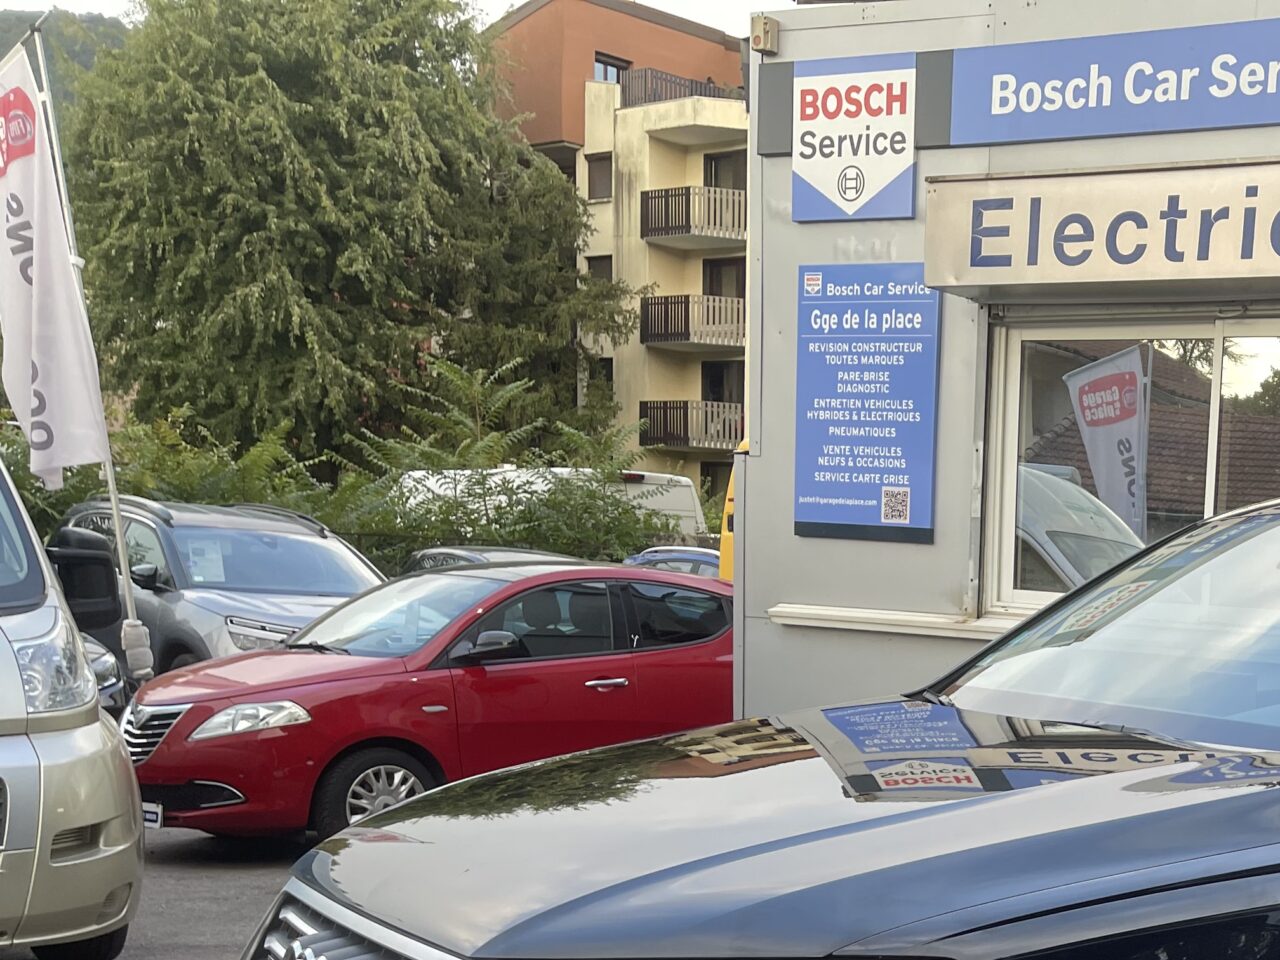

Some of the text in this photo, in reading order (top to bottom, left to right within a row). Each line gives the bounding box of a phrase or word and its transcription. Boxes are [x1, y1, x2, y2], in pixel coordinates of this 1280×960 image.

[990, 63, 1112, 116] Bosch
[1124, 60, 1200, 106] Car
[799, 81, 908, 121] BOSCH
[798, 124, 907, 160] Service
[826, 283, 861, 296] Bosch
[864, 282, 884, 295] Car
[811, 308, 922, 334] Gge de la place
[808, 342, 923, 353] REVISION CONSTRUCTEUR
[825, 355, 904, 365] TOUTES MARQUES
[837, 371, 890, 382] PARE-BRISE
[837, 383, 890, 393] DIAGNOSTIC
[814, 398, 914, 409] ENTRETIEN VEHICULES
[807, 410, 921, 422] HYBRIDES & ELECTRIQUES
[828, 426, 897, 438] PNEUMATIQUES
[823, 445, 902, 457] VENTE VEHICULES
[818, 457, 907, 469] NEUFS & OCCASIONS
[814, 471, 910, 485] SERVICE CARTE GRISE
